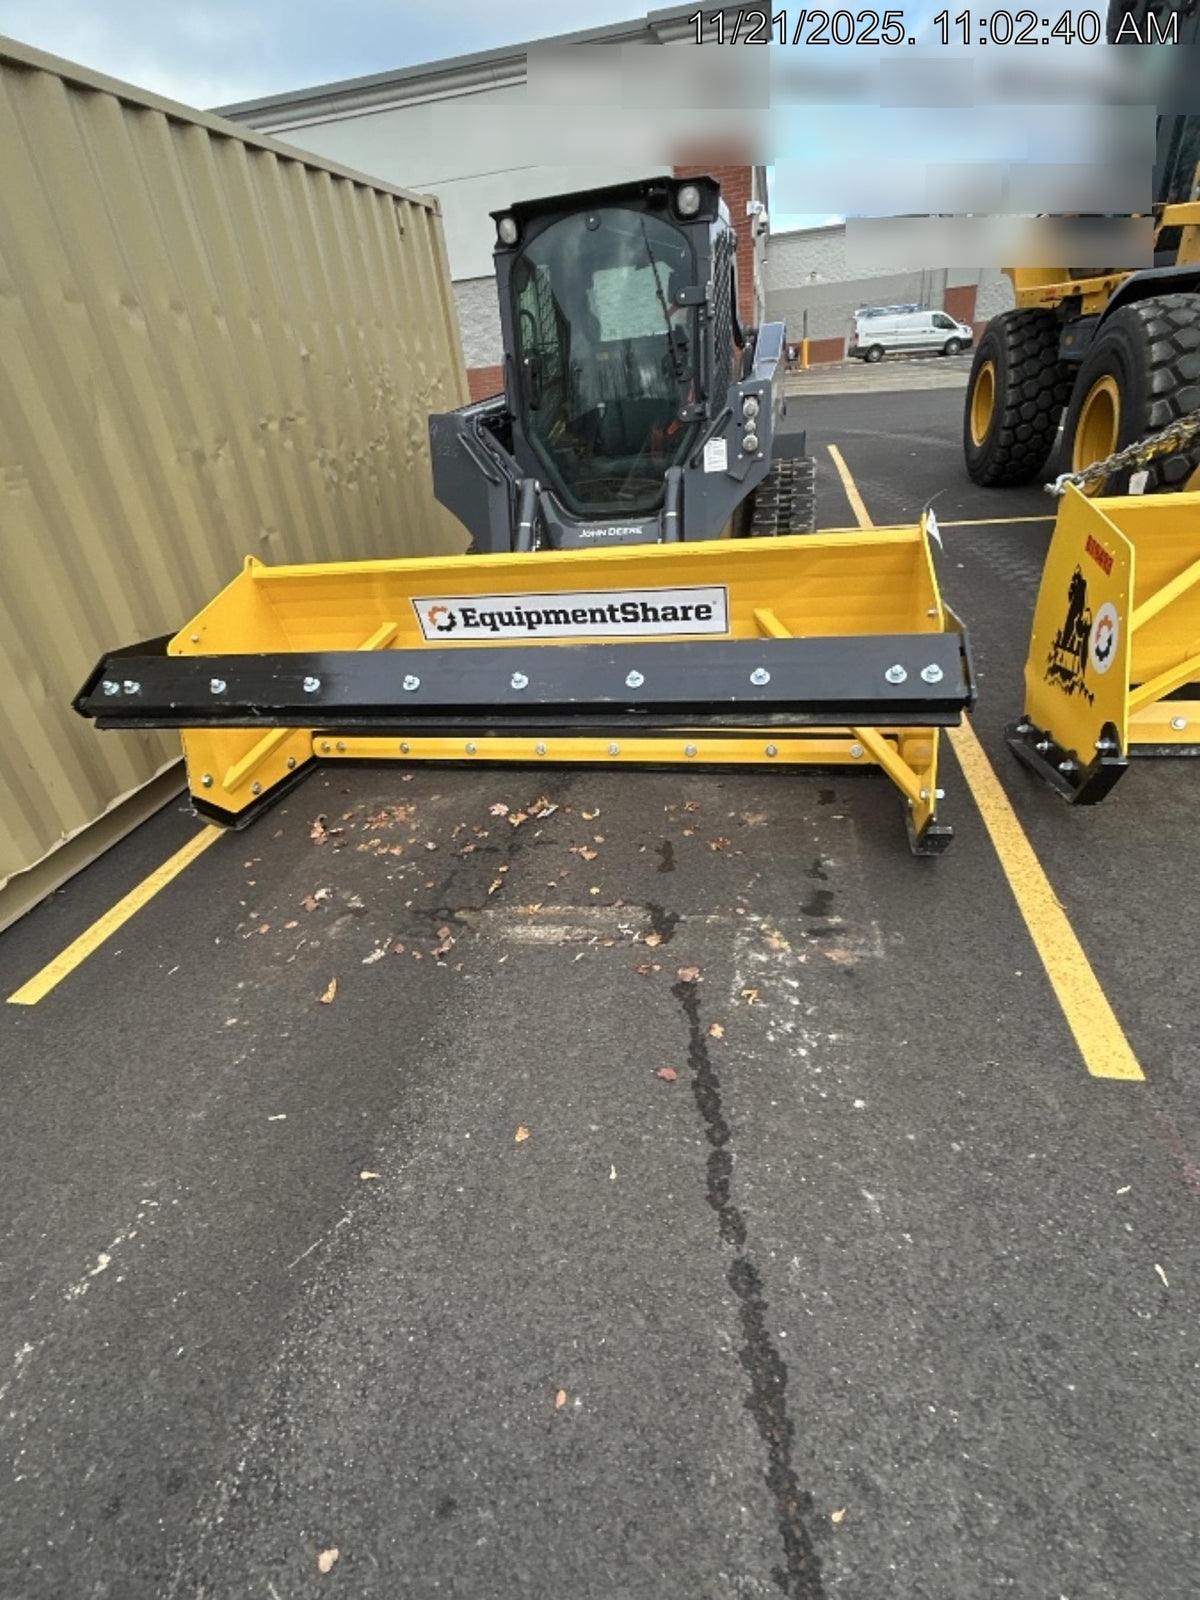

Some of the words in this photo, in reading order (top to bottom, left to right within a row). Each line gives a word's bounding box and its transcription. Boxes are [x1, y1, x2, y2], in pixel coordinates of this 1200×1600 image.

[578, 528, 607, 539] JOHN
[608, 526, 643, 537] DEERE
[459, 602, 713, 632] EquipmentShare
